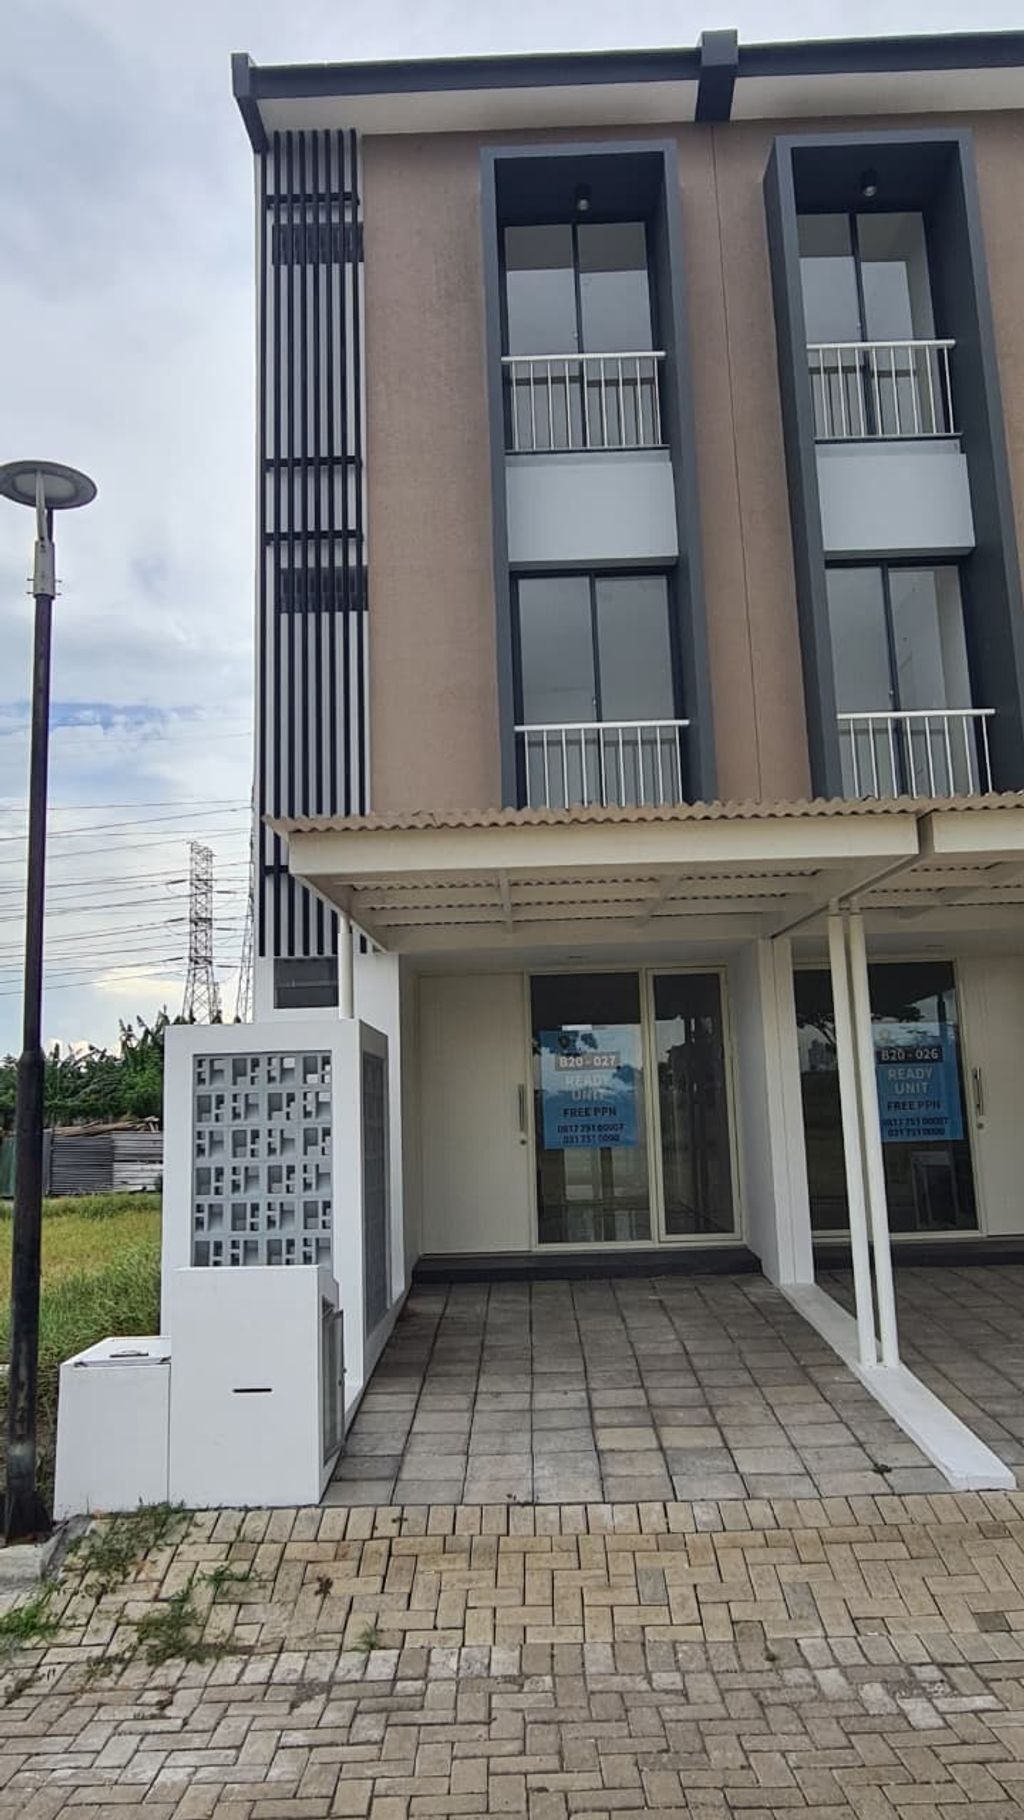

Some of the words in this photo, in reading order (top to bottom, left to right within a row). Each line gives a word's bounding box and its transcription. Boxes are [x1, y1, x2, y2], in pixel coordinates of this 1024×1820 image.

[882, 1049, 905, 1060] B20
[915, 1048, 938, 1059] 026
[560, 1057, 583, 1068] B20
[593, 1055, 616, 1066] 027
[888, 1067, 932, 1080] READY
[895, 1081, 928, 1094] UNIT
[563, 1107, 590, 1118] FREE
[593, 1106, 617, 1116] PPN
[888, 1101, 916, 1111] FREE
